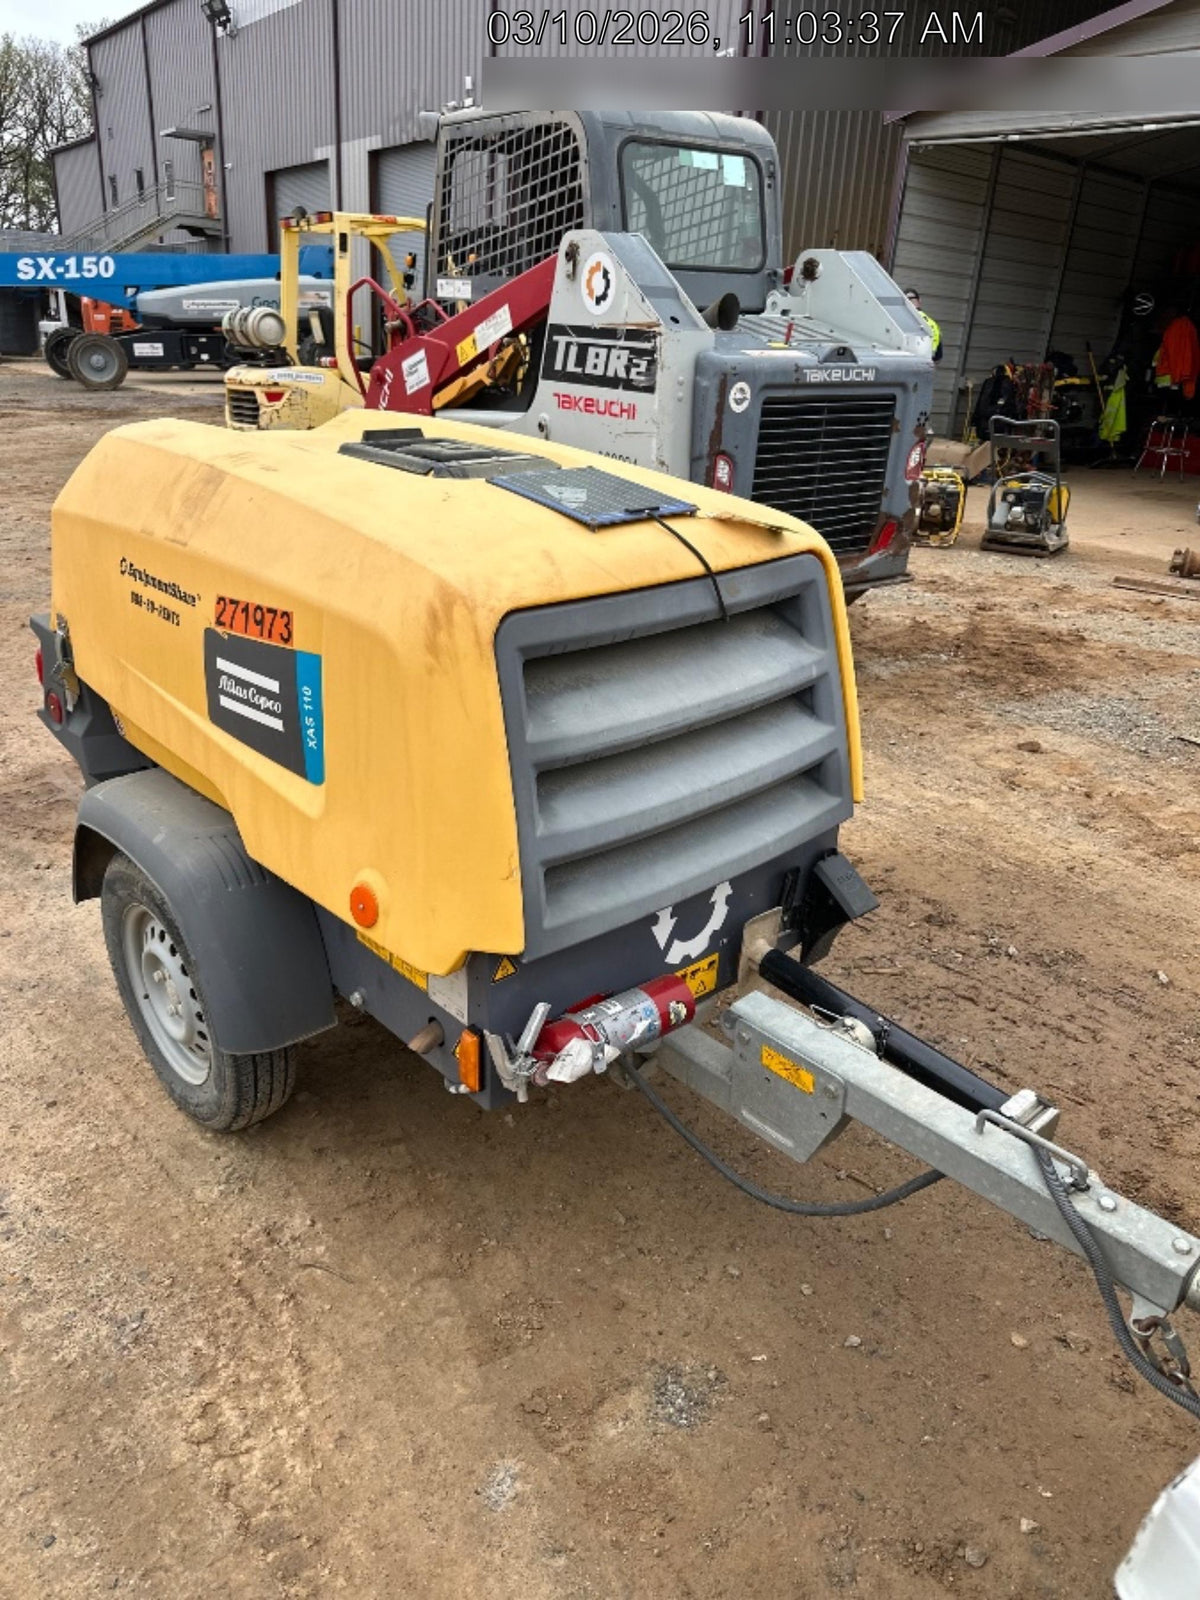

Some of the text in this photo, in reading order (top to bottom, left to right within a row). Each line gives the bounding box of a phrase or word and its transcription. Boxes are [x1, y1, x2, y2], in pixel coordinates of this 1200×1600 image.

[16, 255, 116, 280] SX-150
[214, 596, 293, 645] 271973
[218, 674, 283, 714] Atlas Copco
[301, 685, 318, 750] XAS 110
